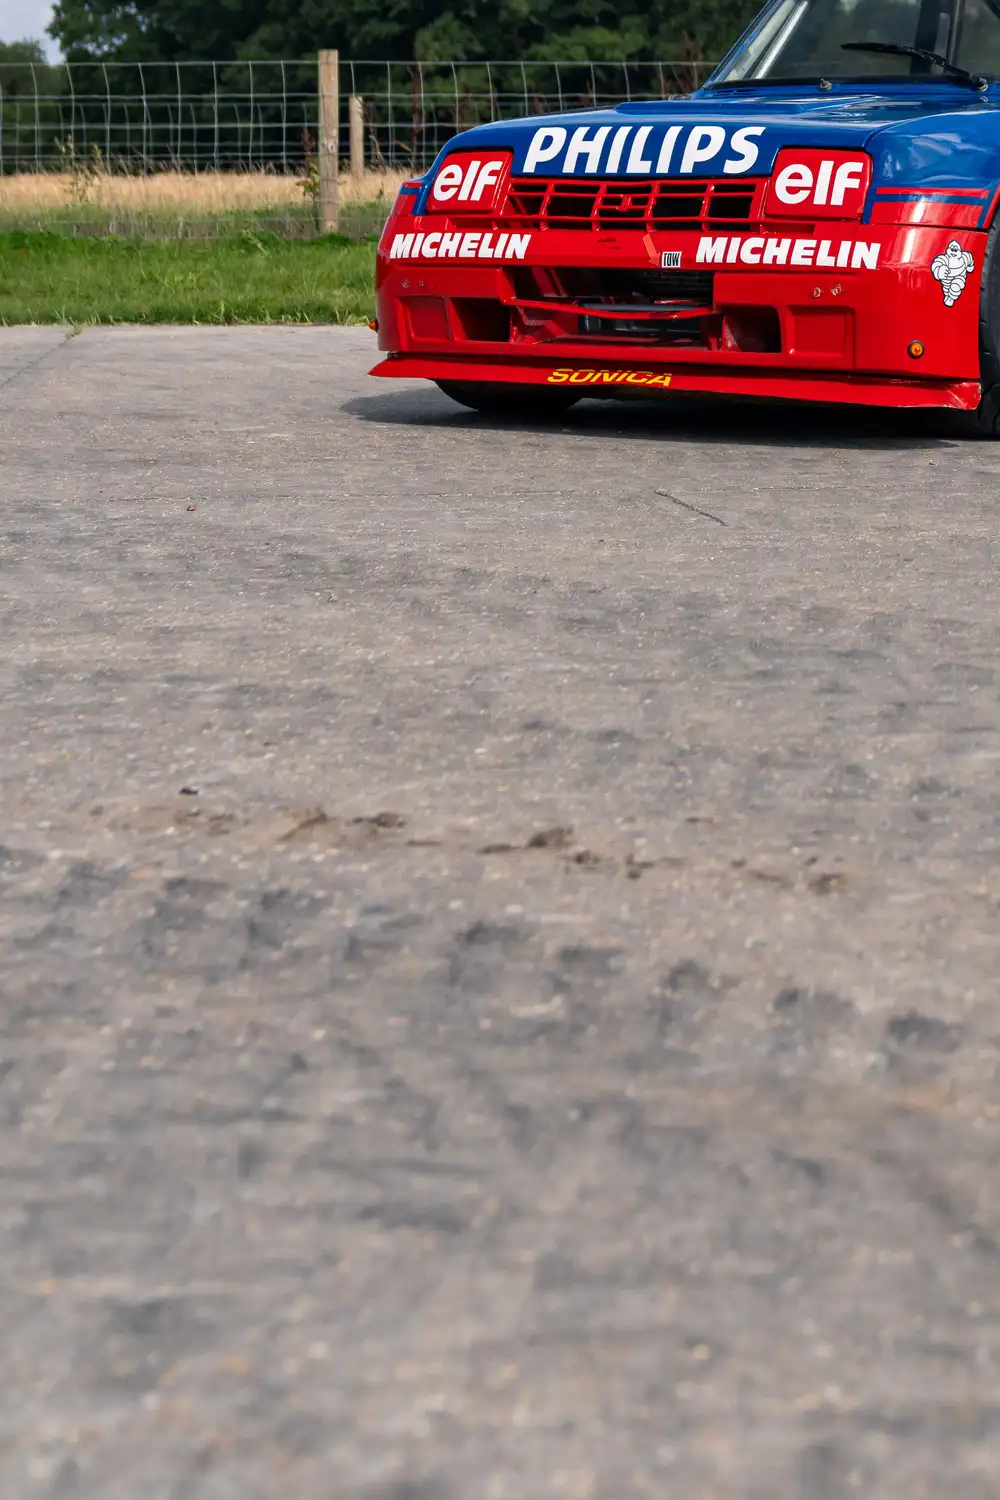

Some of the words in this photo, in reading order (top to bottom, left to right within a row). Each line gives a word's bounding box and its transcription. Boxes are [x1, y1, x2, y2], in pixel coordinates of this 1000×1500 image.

[522, 126, 767, 174] PHILIPS
[433, 160, 503, 201] elf
[775, 160, 864, 206] elf
[389, 232, 532, 260] MICHELIN
[663, 252, 681, 266] TOW
[695, 236, 881, 271] MICHELIN
